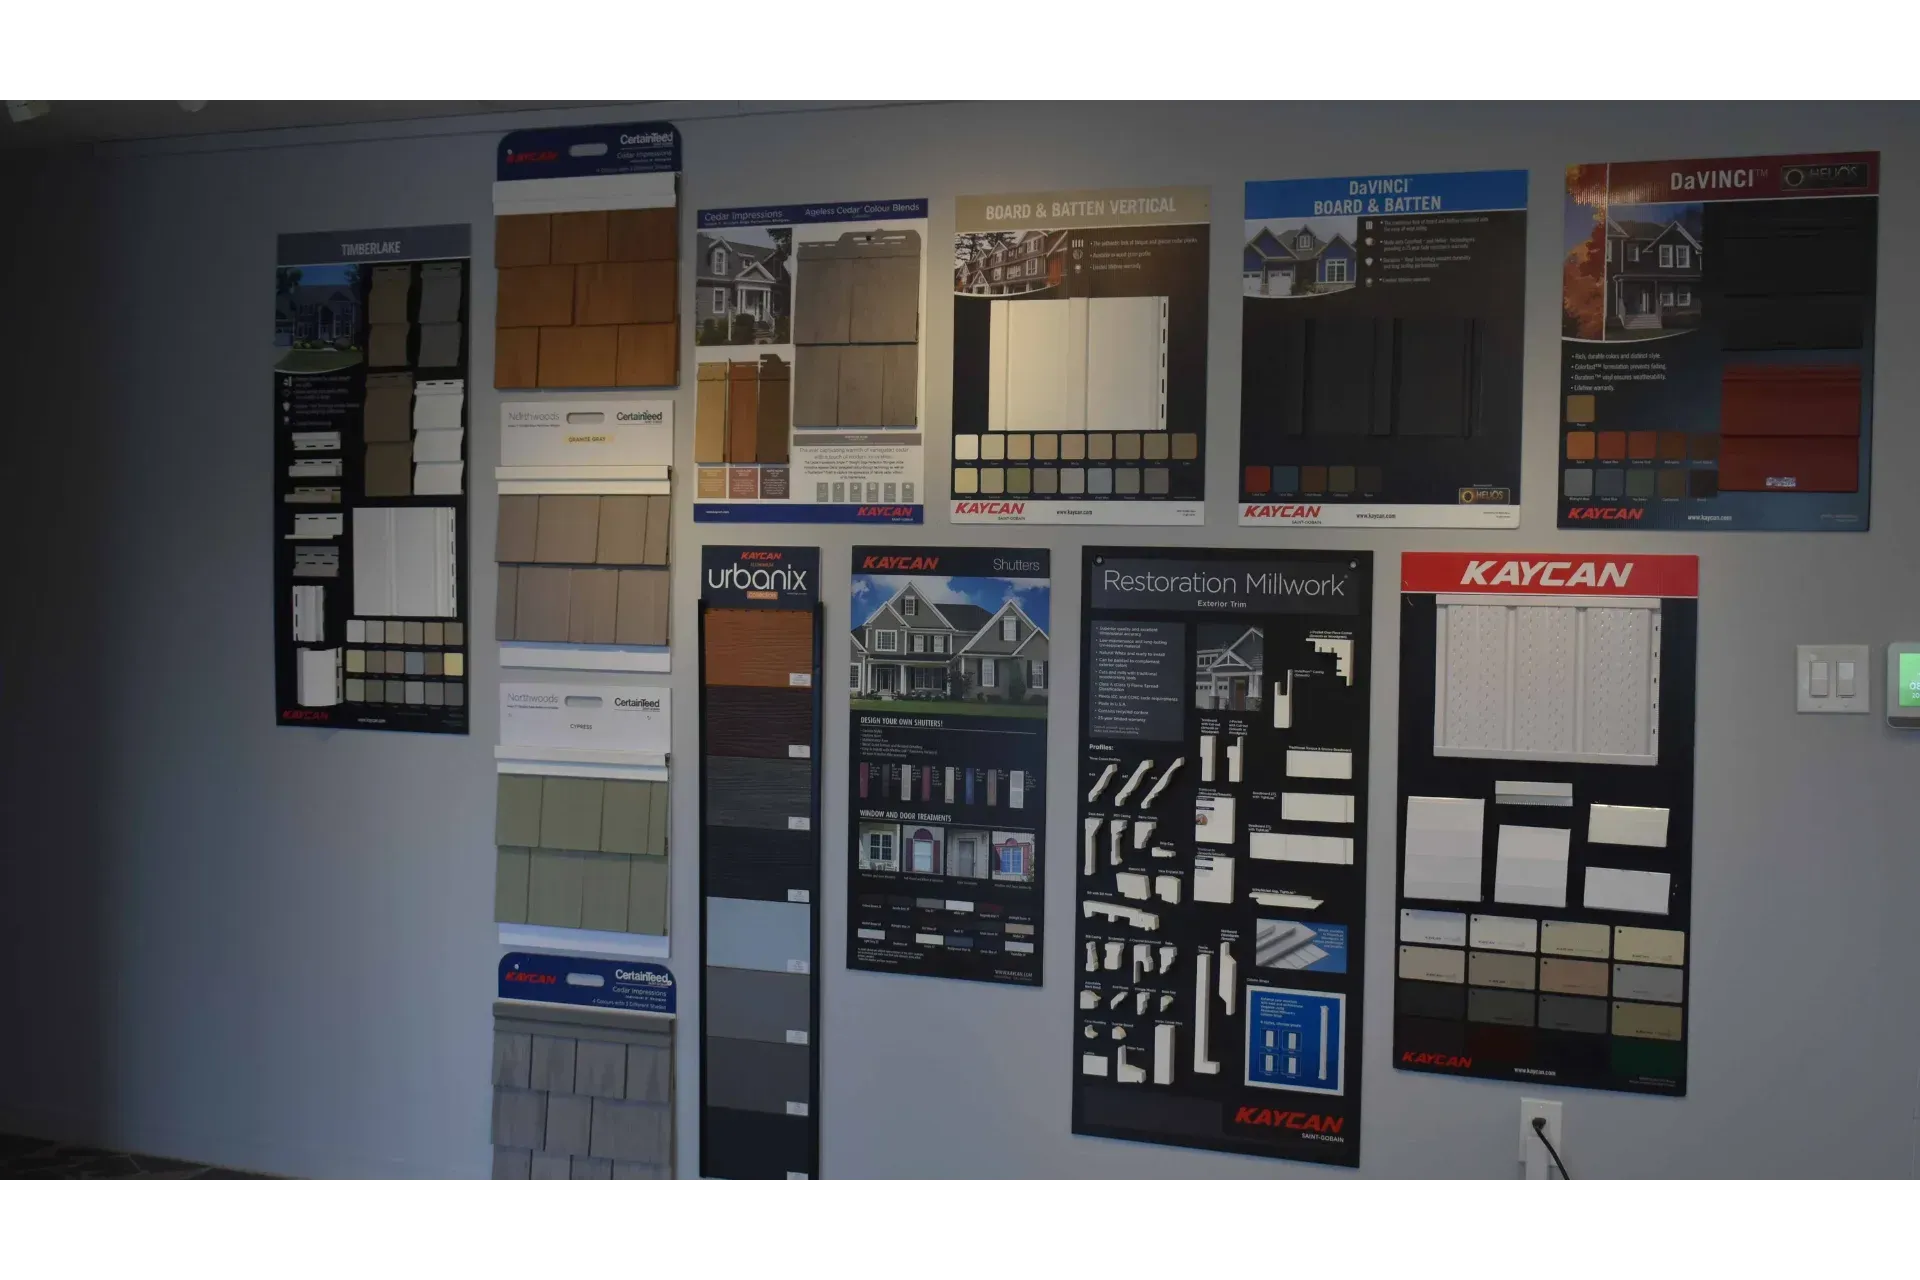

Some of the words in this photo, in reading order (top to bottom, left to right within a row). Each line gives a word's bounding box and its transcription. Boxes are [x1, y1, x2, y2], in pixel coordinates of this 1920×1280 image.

[620, 132, 674, 145] CertainTeed
[805, 207, 835, 218] Ageless
[863, 204, 890, 214] Colour
[892, 203, 920, 213] Blends
[986, 204, 1031, 220] BOARD
[1035, 203, 1048, 218] &
[1051, 200, 1105, 217] BATTEN
[1109, 196, 1177, 215] VERTICAL
[1314, 199, 1363, 216] BOARD
[1367, 198, 1380, 213] &
[1384, 195, 1442, 212] BATTEN
[704, 211, 730, 222] Cedar
[732, 209, 783, 222] Impressions
[341, 240, 401, 256] TIMBERLAKE
[508, 411, 560, 421] Northwoods
[616, 410, 662, 421] CertainTeed
[857, 506, 914, 516] KAYCAN
[955, 503, 1025, 514] KAYCAN
[1056, 509, 1093, 517] www.kaycan.com
[1244, 505, 1322, 518] KAYCAN
[1568, 507, 1645, 521] KAYCAN
[1356, 512, 1396, 520] www.kaycan.com
[1687, 513, 1733, 523] www.kaycan.com
[740, 551, 783, 560] KAYCAN
[863, 556, 940, 570] KAYCAN
[993, 557, 1040, 571] Shutters
[708, 562, 807, 591] urbanix
[1460, 560, 1634, 588] KAYCAN
[1104, 569, 1237, 594] Restoration
[1197, 599, 1228, 608] Exterior
[1230, 600, 1247, 609] Trim
[507, 693, 559, 704] Northwoods
[614, 697, 660, 708] CertainTeed
[860, 716, 881, 725] DESIGN
[881, 717, 898, 726] YOUR
[898, 718, 913, 727] OWN
[914, 718, 943, 729] SHUTTERS!
[1089, 743, 1114, 751] Profiles:
[860, 809, 885, 818] WINDOW
[885, 810, 899, 819] AND
[899, 811, 916, 820] DOOR
[917, 813, 952, 823] TREATMENTS
[505, 971, 557, 984] KAYCAN
[615, 968, 669, 983] CertainTeed
[612, 985, 630, 994] Cedar
[631, 987, 667, 997] Impressions
[1402, 1050, 1473, 1069] KAYCAN
[1514, 1067, 1556, 1077] www.kaycan.com
[1234, 1104, 1344, 1134] KAYCAN
[1301, 1132, 1345, 1143] SAINT-GOBAIN
